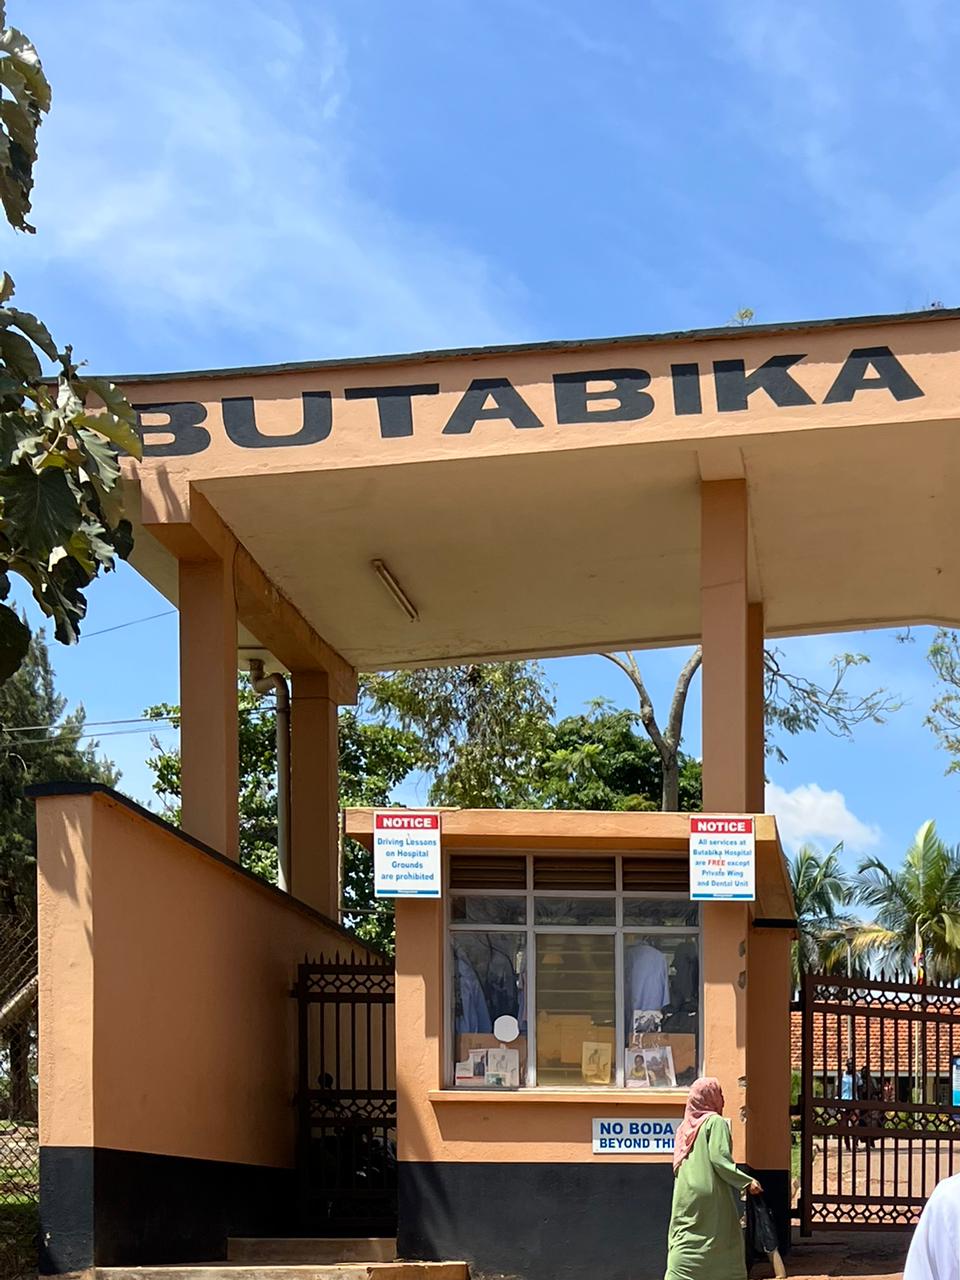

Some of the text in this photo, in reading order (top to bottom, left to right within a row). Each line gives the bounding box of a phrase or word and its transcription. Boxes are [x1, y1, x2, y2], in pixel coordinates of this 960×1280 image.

[112, 345, 925, 457] BUTABIKA
[383, 818, 432, 827] NOTICE
[698, 822, 746, 832] NOTICE
[377, 838, 437, 847] Driving Lessons
[397, 849, 429, 858] Hospital
[724, 849, 752, 857] Hospital
[391, 861, 423, 869] Grounds
[396, 872, 434, 882] prohibited
[600, 1122, 674, 1135] NO BODA
[600, 1138, 674, 1148] BEYOND THI
